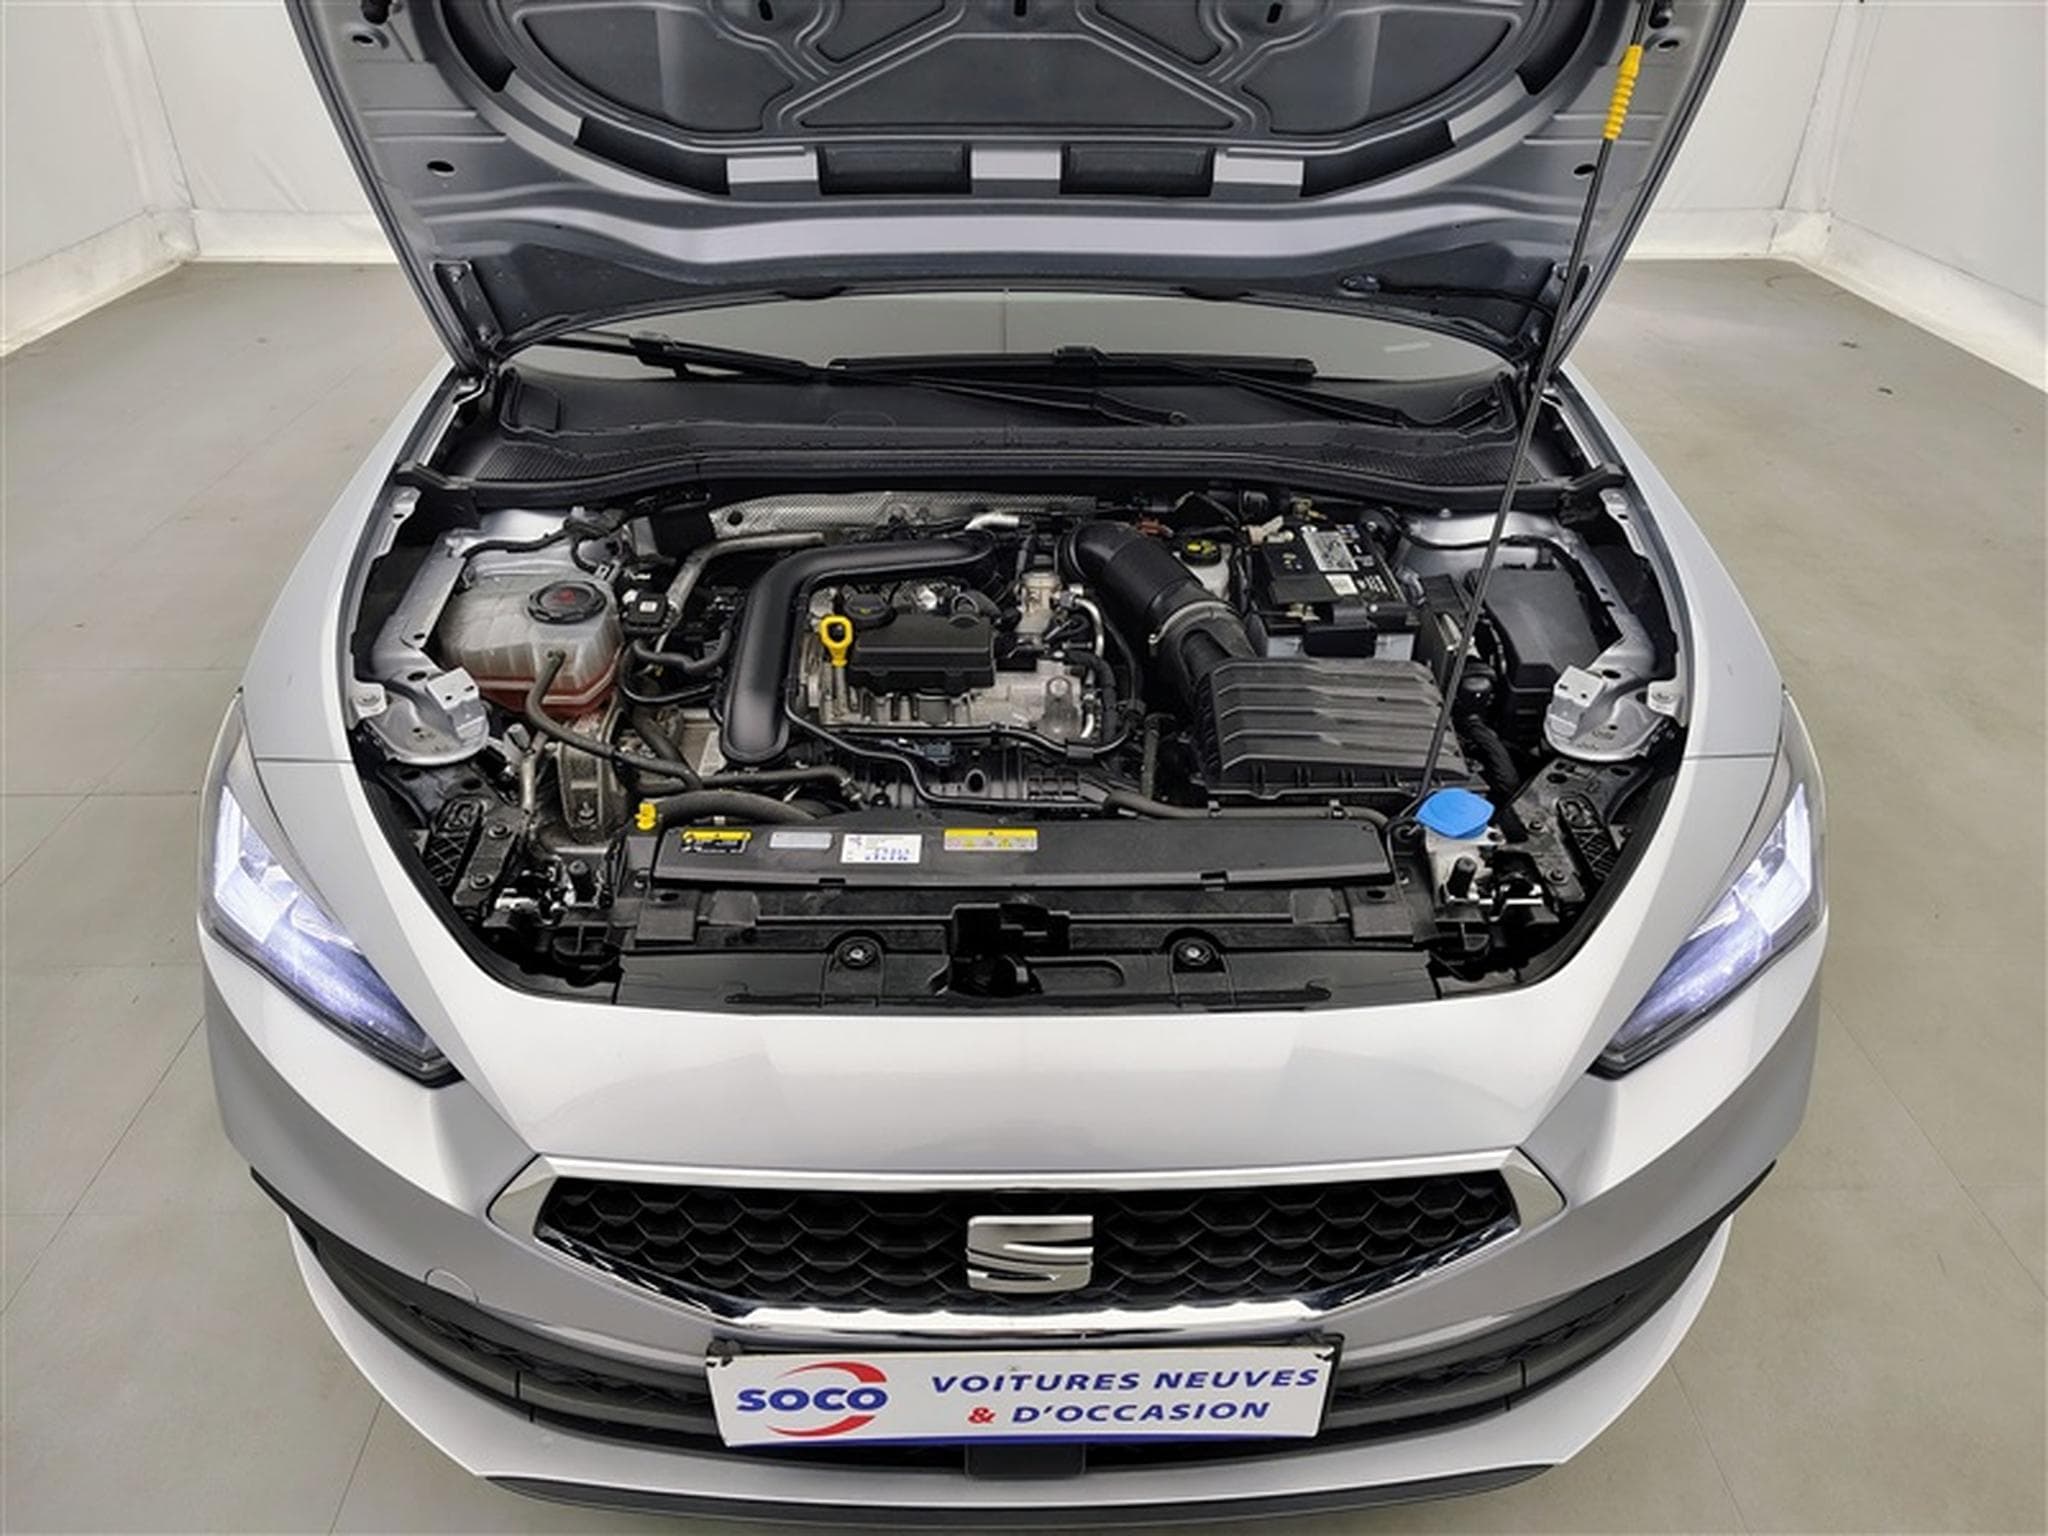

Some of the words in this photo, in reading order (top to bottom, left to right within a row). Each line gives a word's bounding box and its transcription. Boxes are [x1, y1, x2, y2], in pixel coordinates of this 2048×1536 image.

[932, 1373, 1140, 1394] VOITURES
[1154, 1369, 1319, 1389] NEUVES
[737, 1387, 888, 1412] SOCO
[968, 1406, 996, 1424] &
[1012, 1402, 1270, 1423] D'OCCASION
